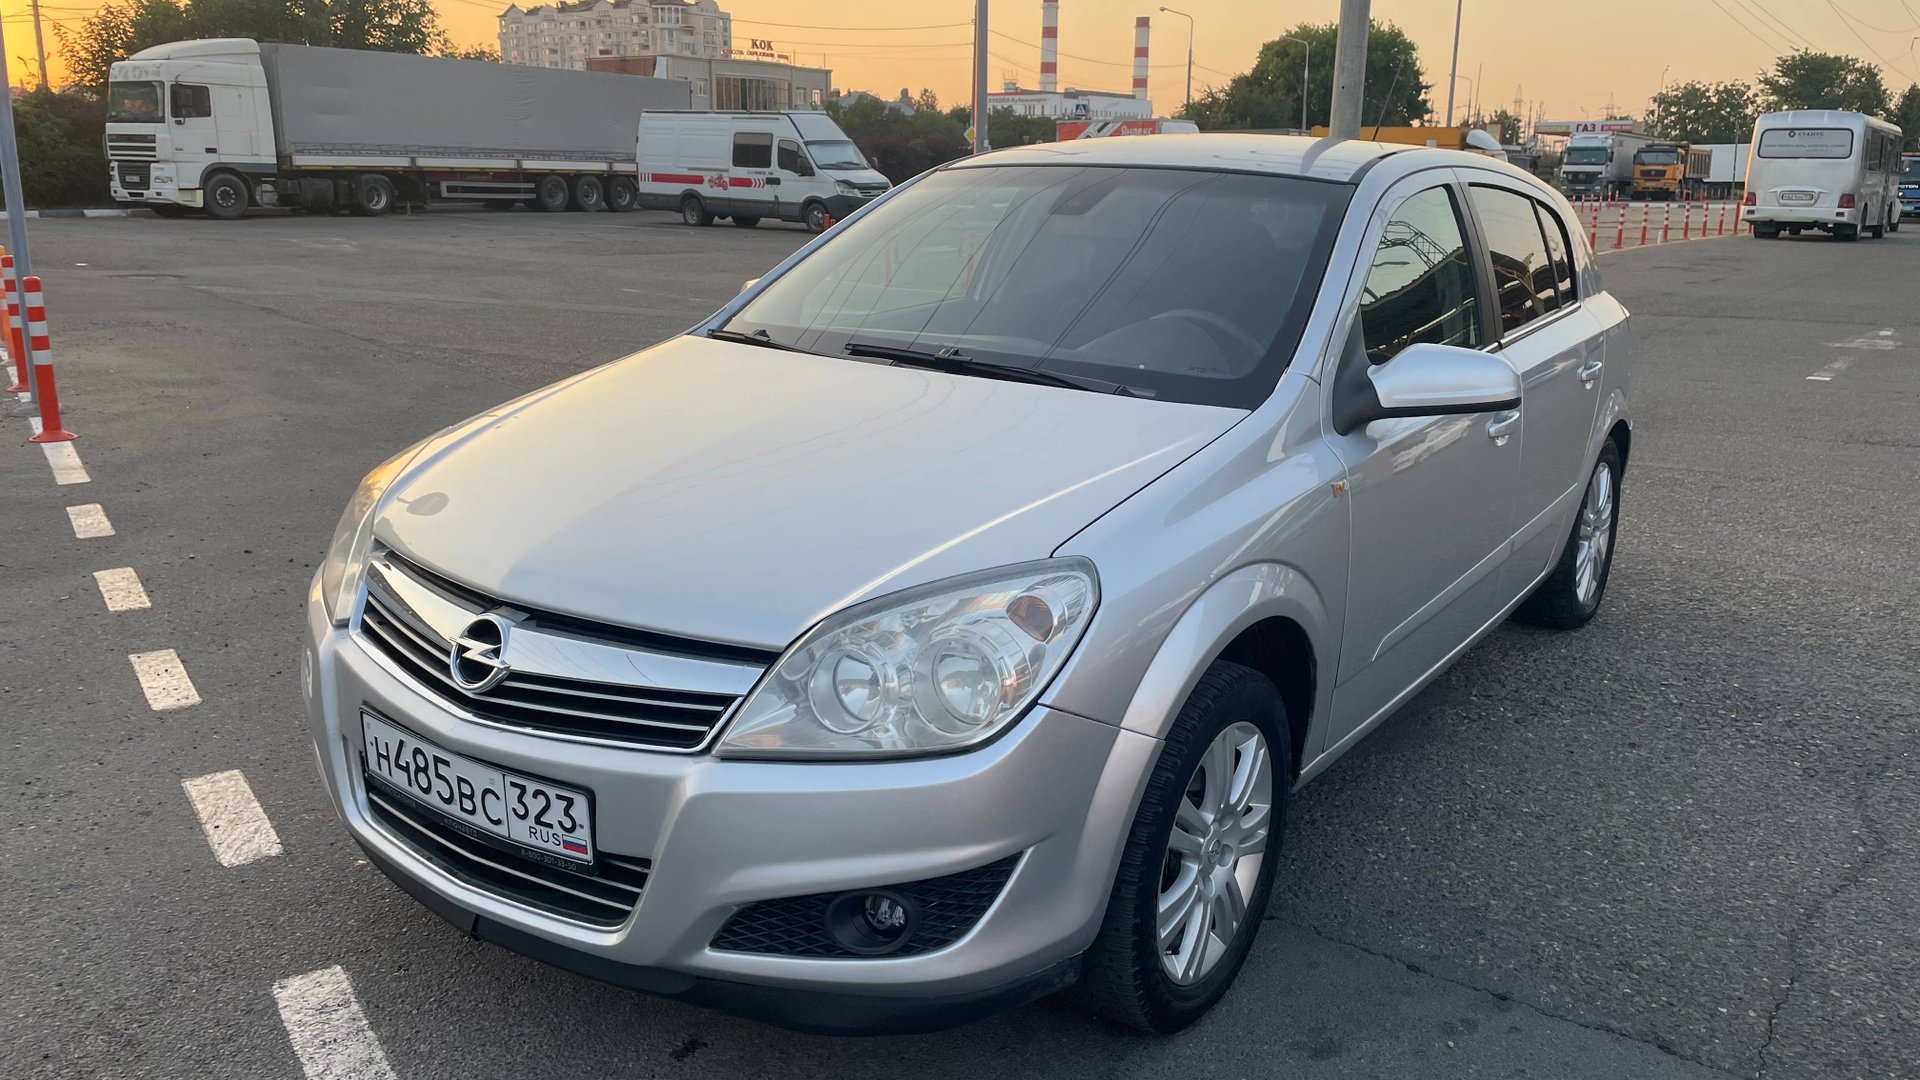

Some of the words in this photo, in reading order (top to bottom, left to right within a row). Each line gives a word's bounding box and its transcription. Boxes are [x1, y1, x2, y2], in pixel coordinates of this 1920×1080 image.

[1121, 125, 1153, 136] Яндекс
[1576, 123, 1596, 133] ГАЗ
[509, 780, 577, 834] 323
[528, 825, 561, 847] RUS
